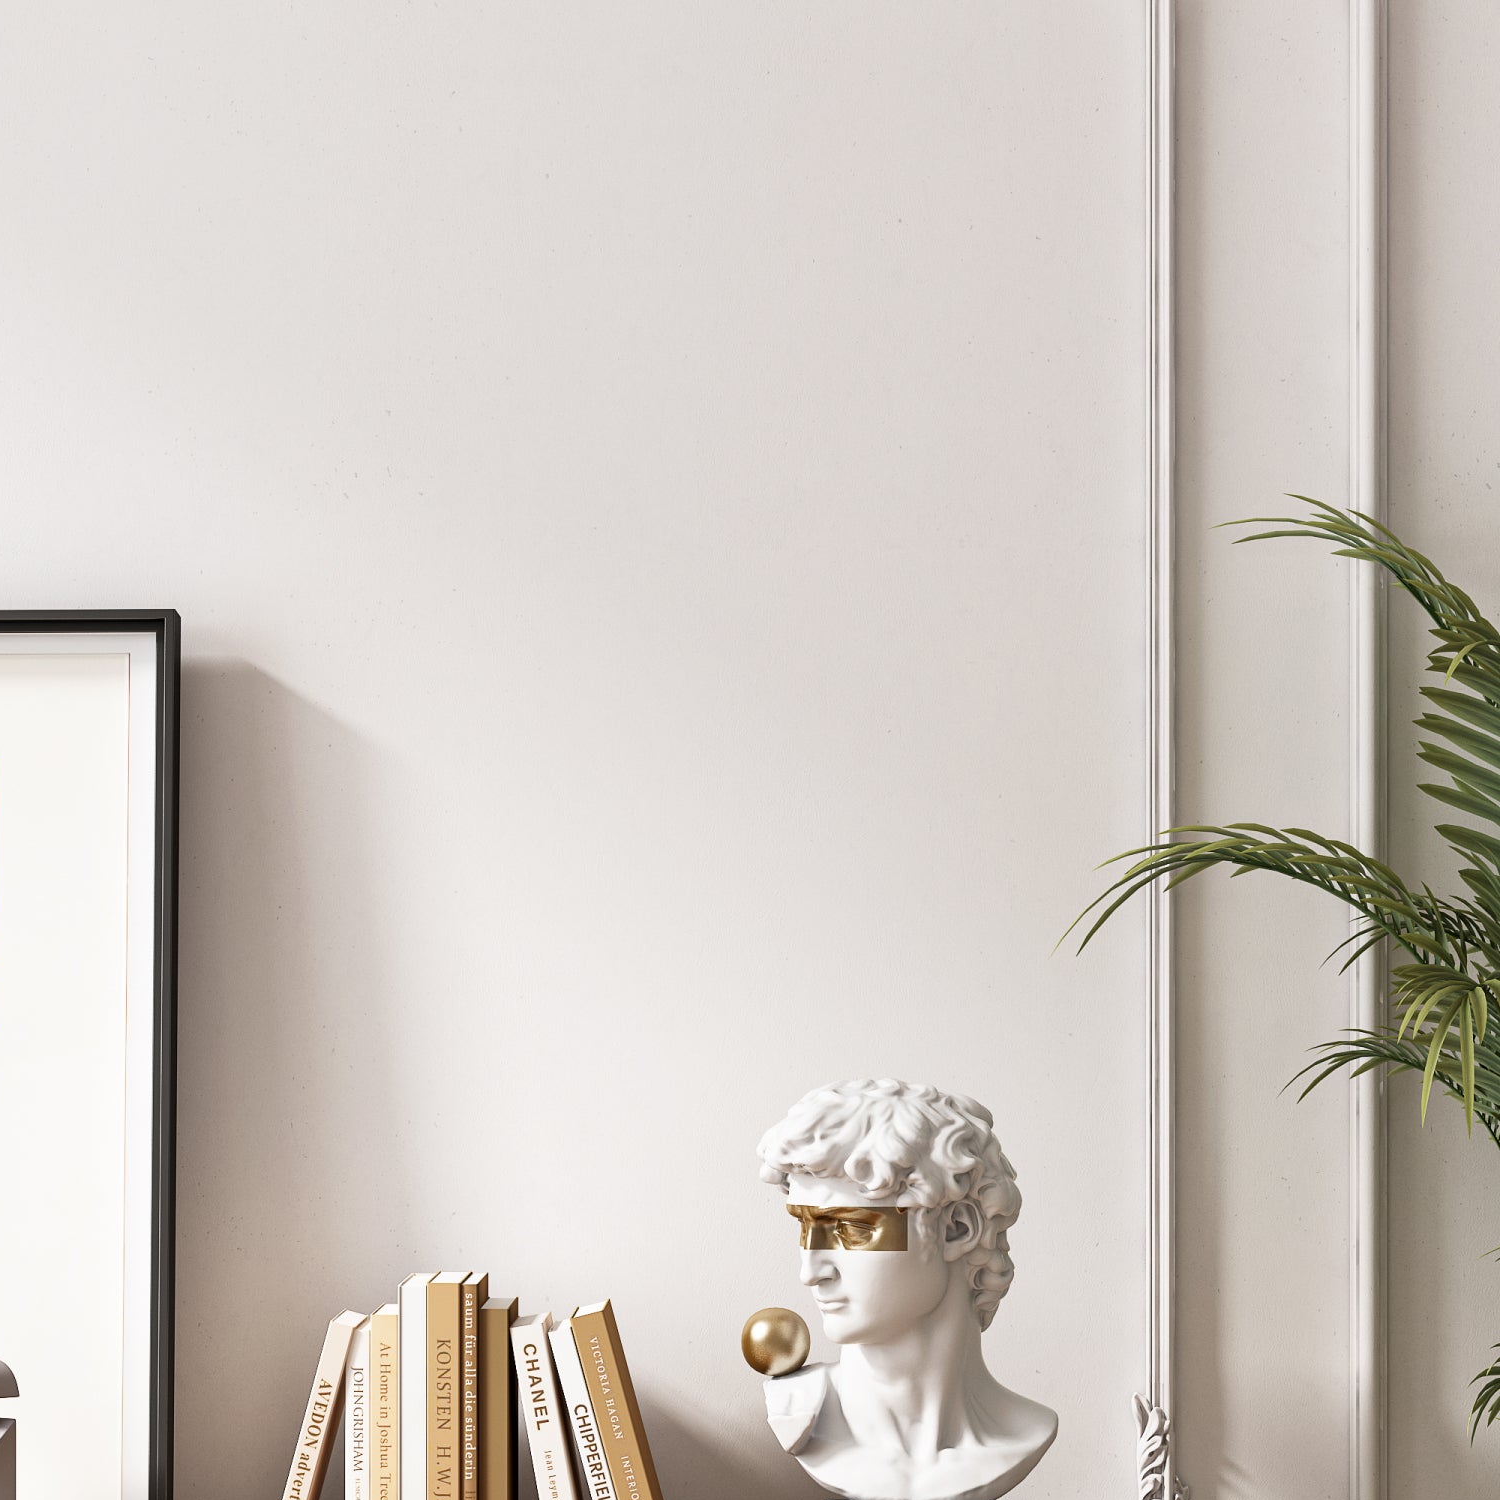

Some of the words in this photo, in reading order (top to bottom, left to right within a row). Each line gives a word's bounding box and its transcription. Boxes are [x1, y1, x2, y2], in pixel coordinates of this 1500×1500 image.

[464, 1293, 473, 1329] saum
[380, 1342, 391, 1358] At
[464, 1334, 477, 1355] für
[380, 1364, 391, 1402] Home
[437, 1340, 451, 1429] KONSTEN
[464, 1360, 476, 1386] alla
[522, 1343, 549, 1432] CHANEL
[590, 1337, 612, 1394] VICTORIA
[605, 1399, 624, 1439] HAGAN
[305, 1378, 334, 1450] AVEDON
[380, 1407, 391, 1419] in
[464, 1391, 476, 1413] die
[377, 1422, 392, 1468] Joshua
[464, 1417, 476, 1480] sünderin
